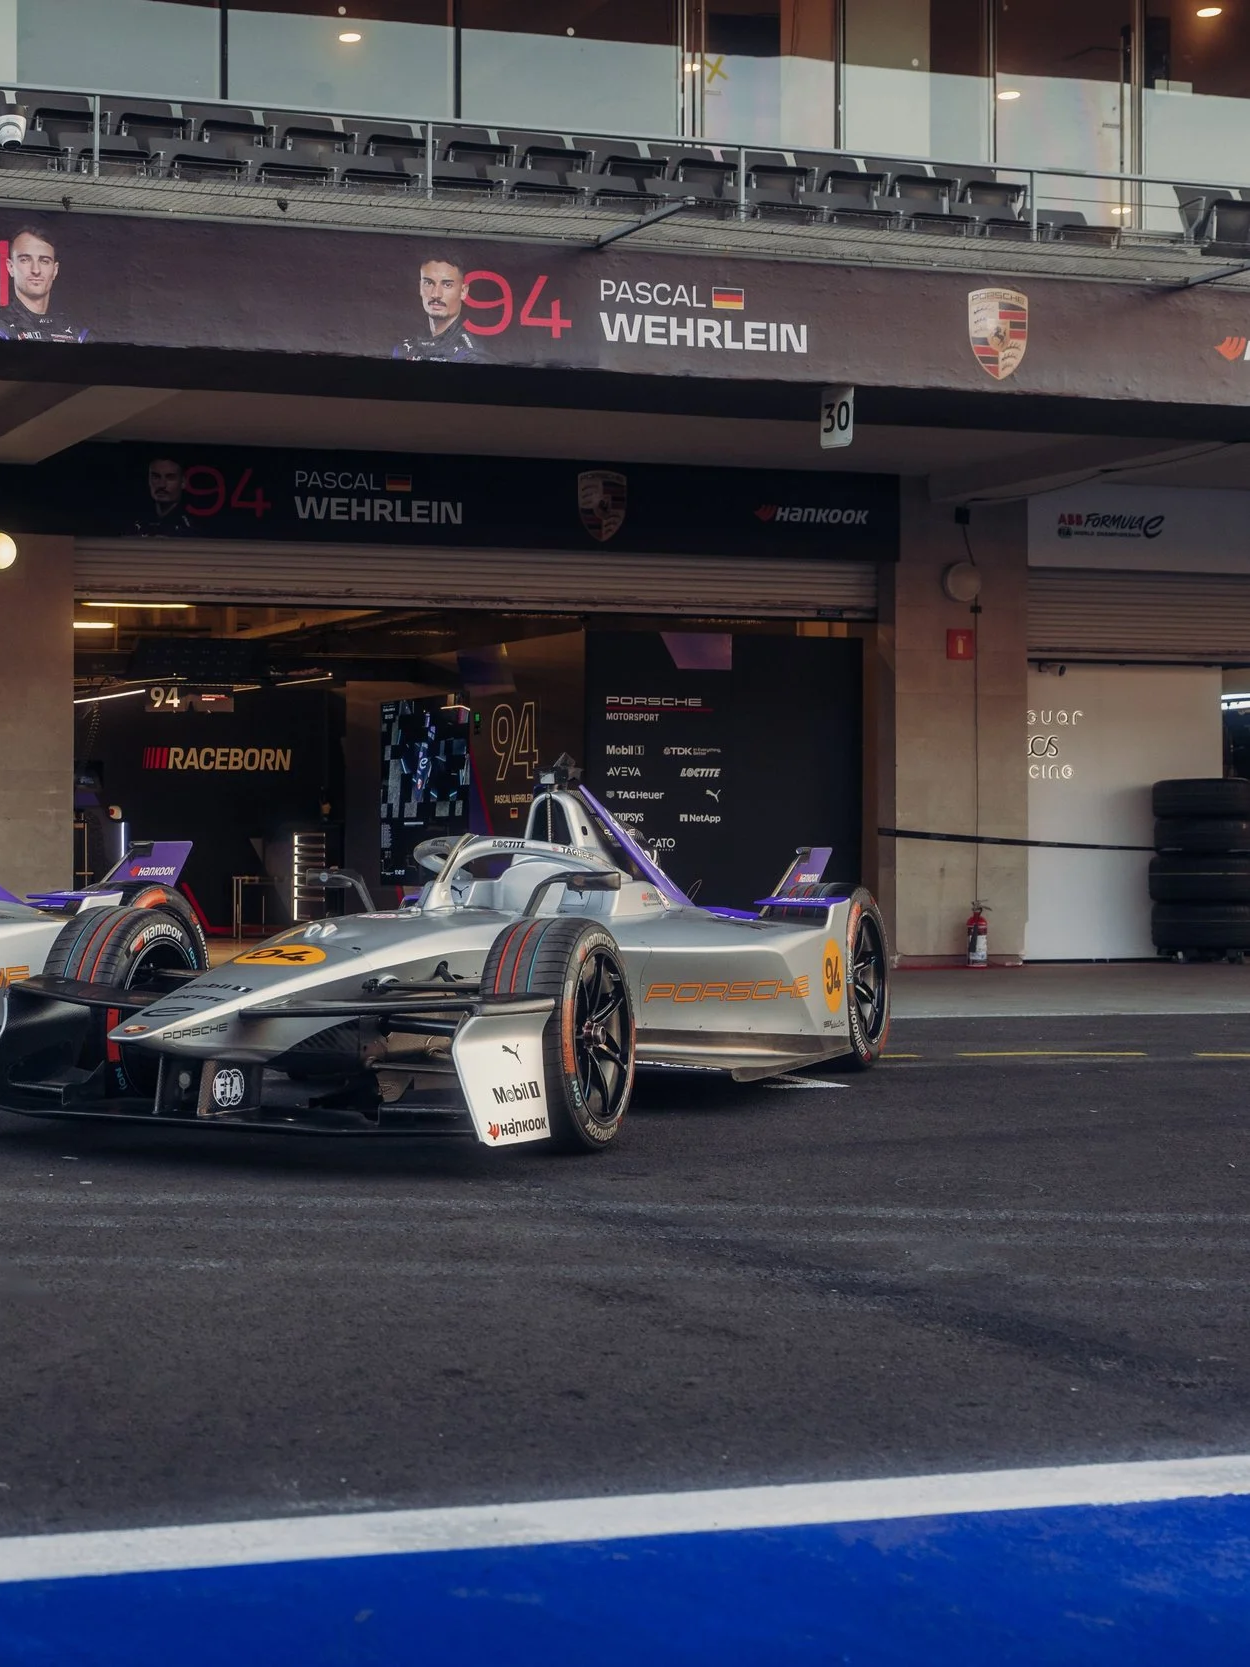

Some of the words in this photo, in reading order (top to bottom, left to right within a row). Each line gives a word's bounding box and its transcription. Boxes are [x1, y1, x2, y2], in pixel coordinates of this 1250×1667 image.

[600, 279, 706, 308] PASCAL
[971, 292, 1026, 305] PORSCHE
[462, 270, 572, 338] 94
[600, 311, 808, 353] WEHRLEIN
[823, 401, 849, 433] 30
[295, 471, 381, 491] PASCAL
[183, 465, 272, 518] 94
[294, 495, 463, 525] WEHRLEIN
[1058, 513, 1083, 526] ABB
[1084, 513, 1145, 531] FORMULA
[150, 687, 180, 708] 94
[606, 696, 702, 706] PORSCHE
[606, 712, 660, 722] MOTORSPORT
[491, 702, 538, 781] 94
[606, 744, 633, 756] Mobil
[635, 745, 644, 755] 1
[669, 746, 693, 756] TDK
[167, 747, 291, 771] RACEBORN
[606, 766, 641, 777] AVEVA
[680, 767, 721, 777] LOCTITE
[689, 814, 721, 824] NetApp
[492, 840, 525, 849] LOCTITE
[245, 949, 312, 961] 94
[825, 956, 842, 995] 94
[643, 975, 810, 1003] PORSCHE
[163, 1023, 229, 1040] PORSCHE
[492, 1082, 530, 1104] Mobil
[528, 1081, 541, 1099] 1
